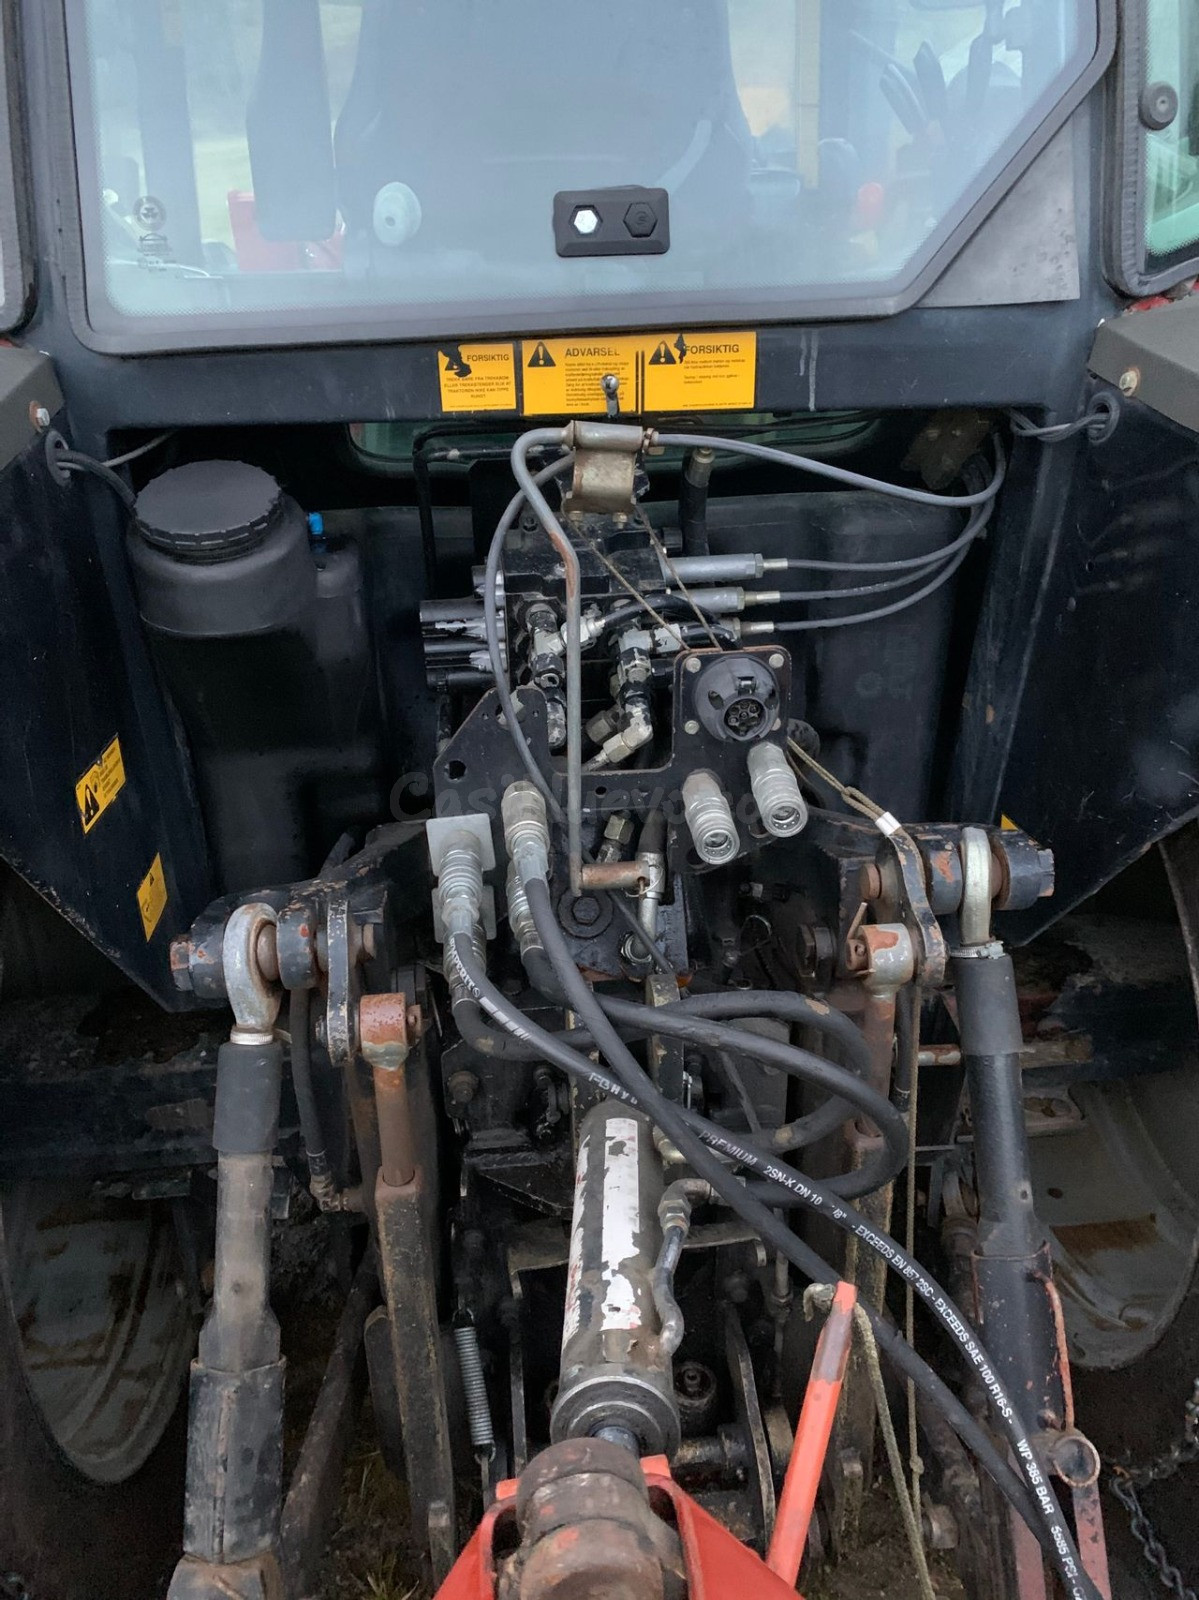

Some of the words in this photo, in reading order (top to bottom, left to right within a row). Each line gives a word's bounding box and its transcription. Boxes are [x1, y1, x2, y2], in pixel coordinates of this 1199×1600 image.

[565, 346, 620, 358] ADVARSEL
[684, 344, 739, 355] FORSIKTIG
[466, 353, 510, 362] FORSIKTIG
[698, 1129, 760, 1167] PREMIUM
[763, 1165, 798, 1188] 2SN-K
[794, 1181, 811, 1201] DN
[810, 1193, 823, 1205] 10
[855, 1224, 895, 1259] EXCEEDS
[891, 1254, 907, 1269] EN
[903, 1265, 920, 1280] 857
[915, 1278, 934, 1297] 2SC
[934, 1297, 970, 1342] EXCEEDS
[965, 1341, 984, 1365] SAE
[979, 1364, 995, 1384] 100
[1017, 1438, 1033, 1461] WP
[1025, 1462, 1043, 1485] 385
[1035, 1487, 1055, 1515] BAR
